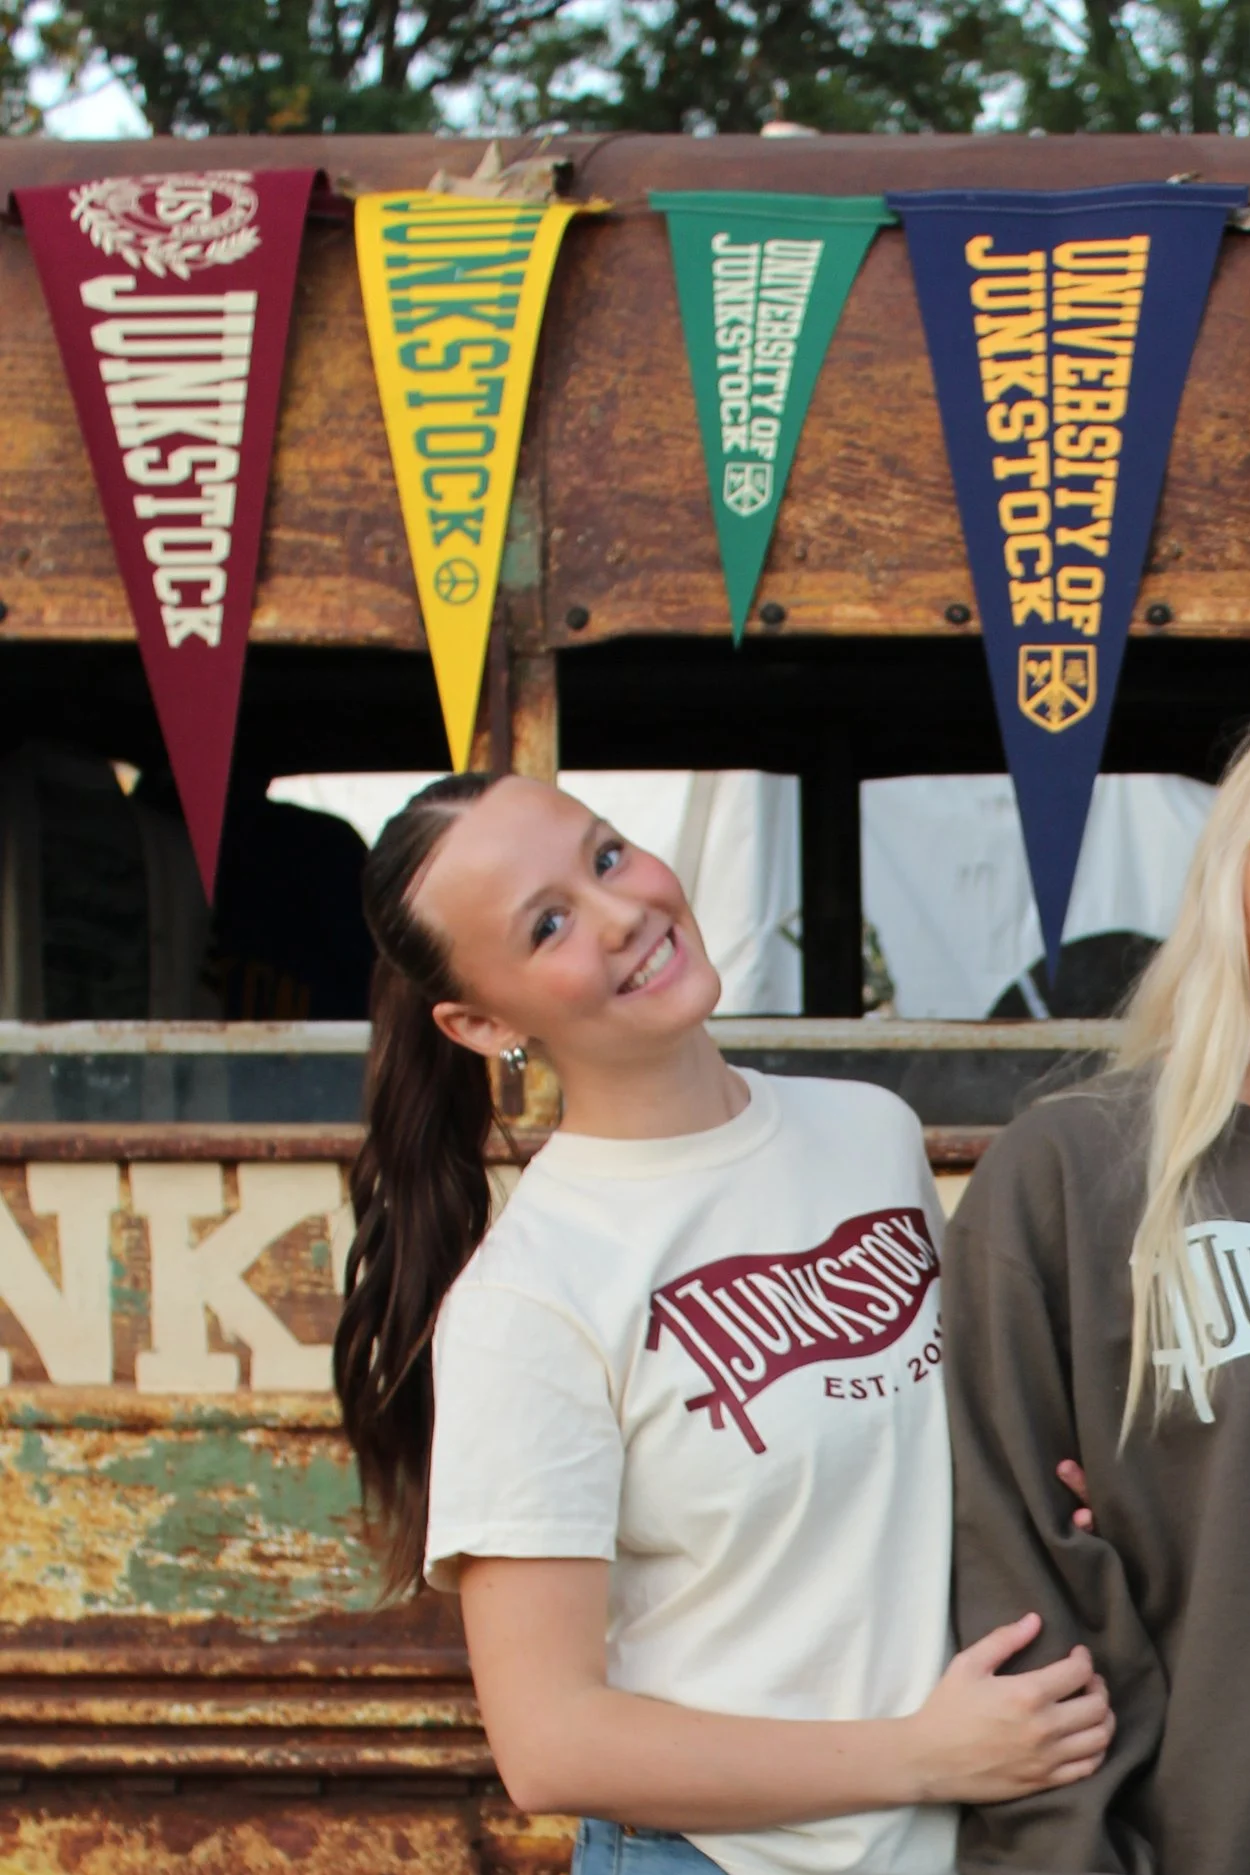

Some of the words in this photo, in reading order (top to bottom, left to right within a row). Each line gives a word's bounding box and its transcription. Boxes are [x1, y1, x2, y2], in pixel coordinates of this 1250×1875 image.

[711, 233, 760, 454] JUNKSTOCK
[754, 238, 825, 421] UNIVERSITY
[1053, 235, 1151, 558] UNIVERSITY
[80, 273, 259, 649] JUNKSTOCK
[749, 421, 782, 460] OF
[965, 235, 1056, 627] JUNKSTOCK
[1057, 565, 1106, 637] OF
[0, 1161, 355, 1394] NK
[675, 1215, 936, 1382] JUNKSTOCK
[824, 1374, 899, 1400] EST.
[907, 1312, 942, 1383] 20
